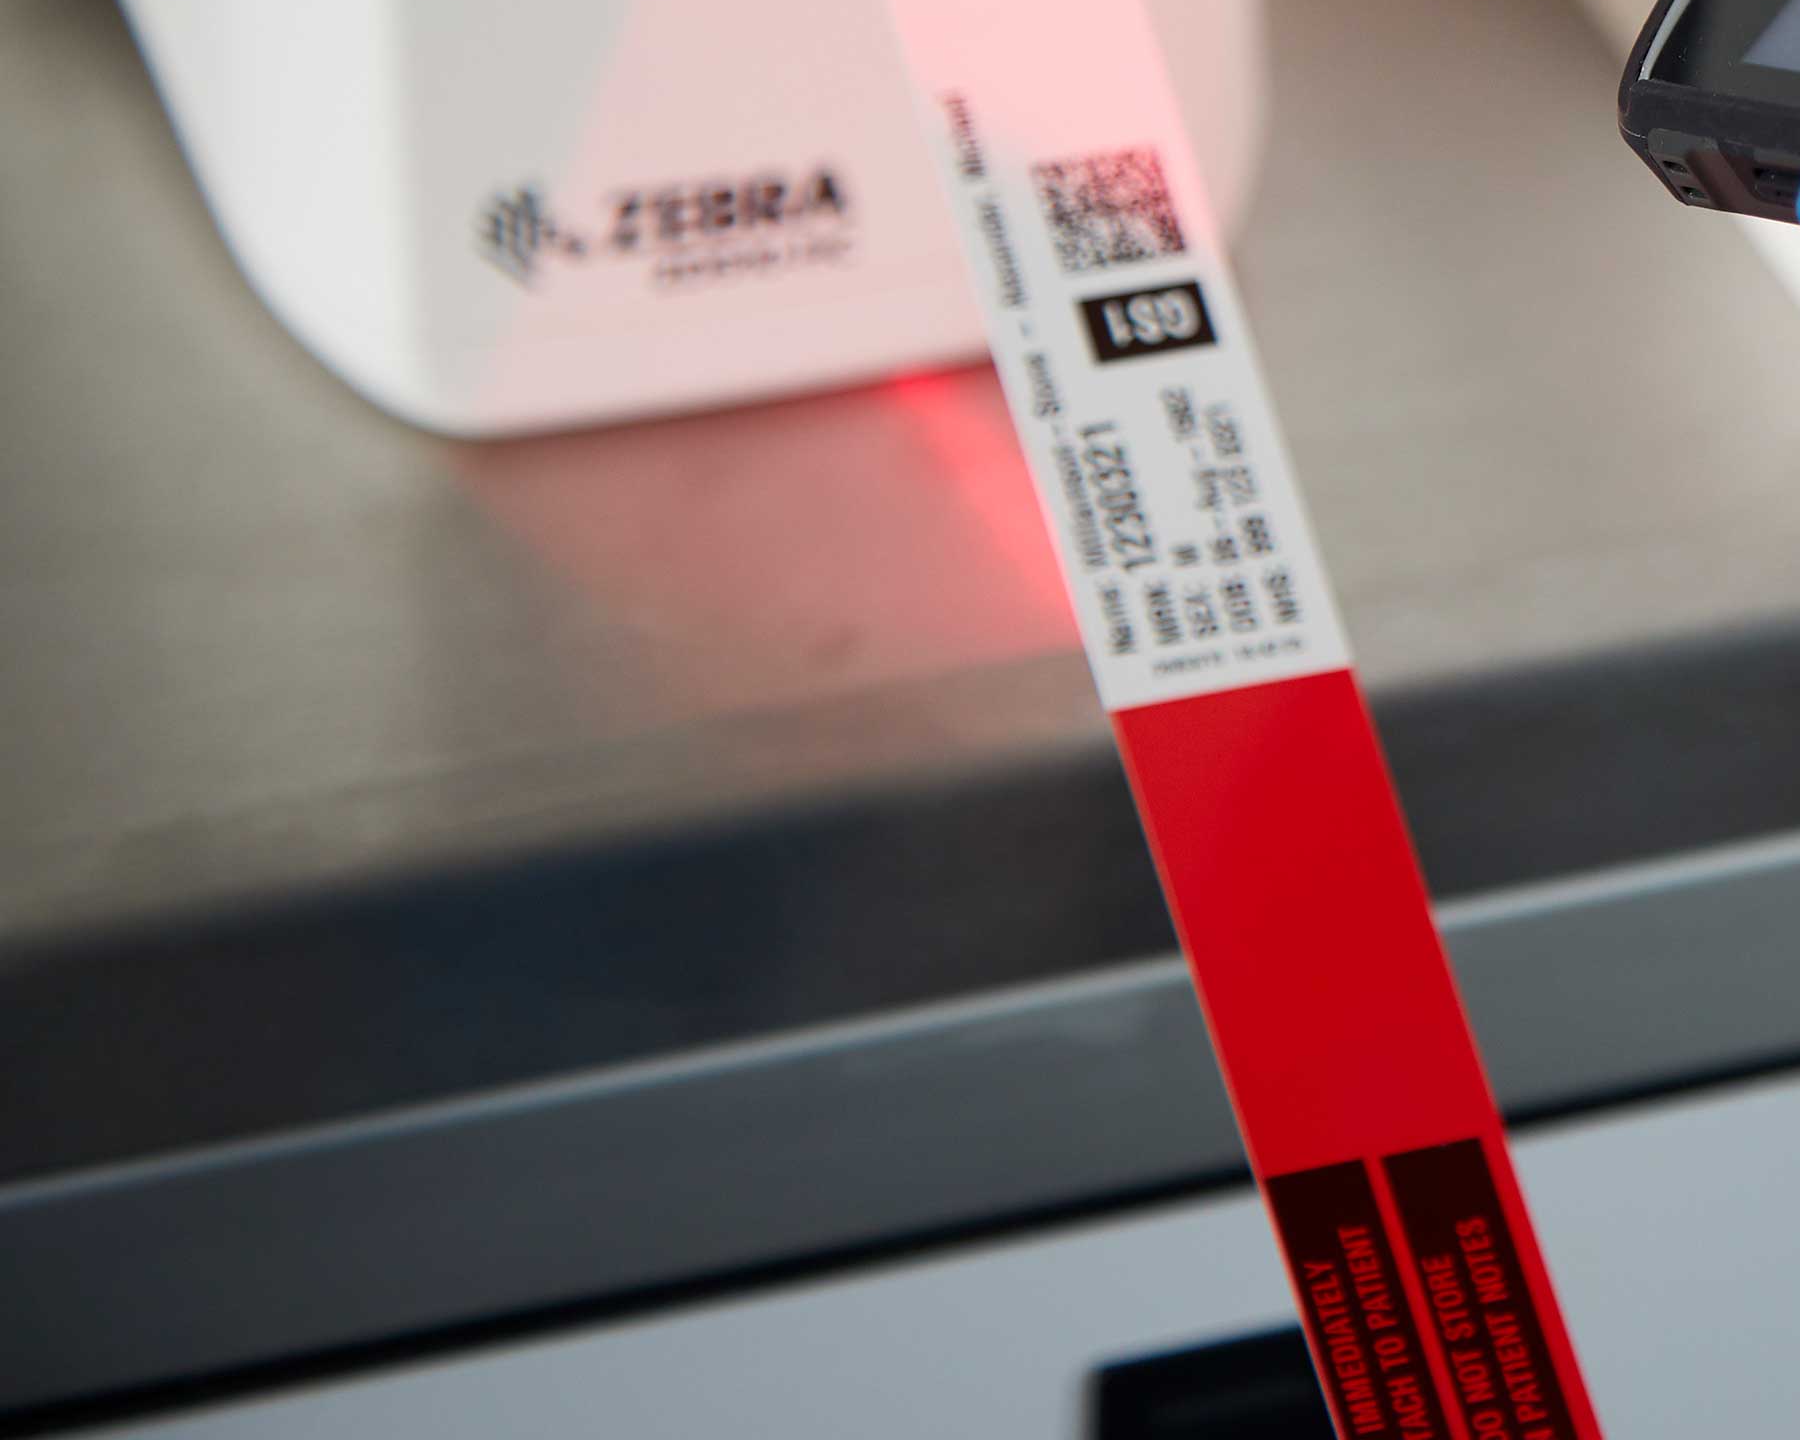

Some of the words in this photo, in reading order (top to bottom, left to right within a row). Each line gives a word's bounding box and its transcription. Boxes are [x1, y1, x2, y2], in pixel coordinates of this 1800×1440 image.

[606, 159, 848, 250] ZEBRA
[1104, 291, 1197, 343] GS1
[1081, 423, 1153, 570] 1230321
[1340, 1228, 1395, 1331] PATIENT
[1423, 1257, 1472, 1339] STORE
[1456, 1218, 1506, 1304] NOTES
[1307, 1264, 1381, 1431] IMMEDIATELY
[1374, 1336, 1408, 1370] TO
[1452, 1352, 1492, 1401] NOT
[1486, 1315, 1545, 1423] PATIENT
[1389, 1377, 1430, 1439] TACH
